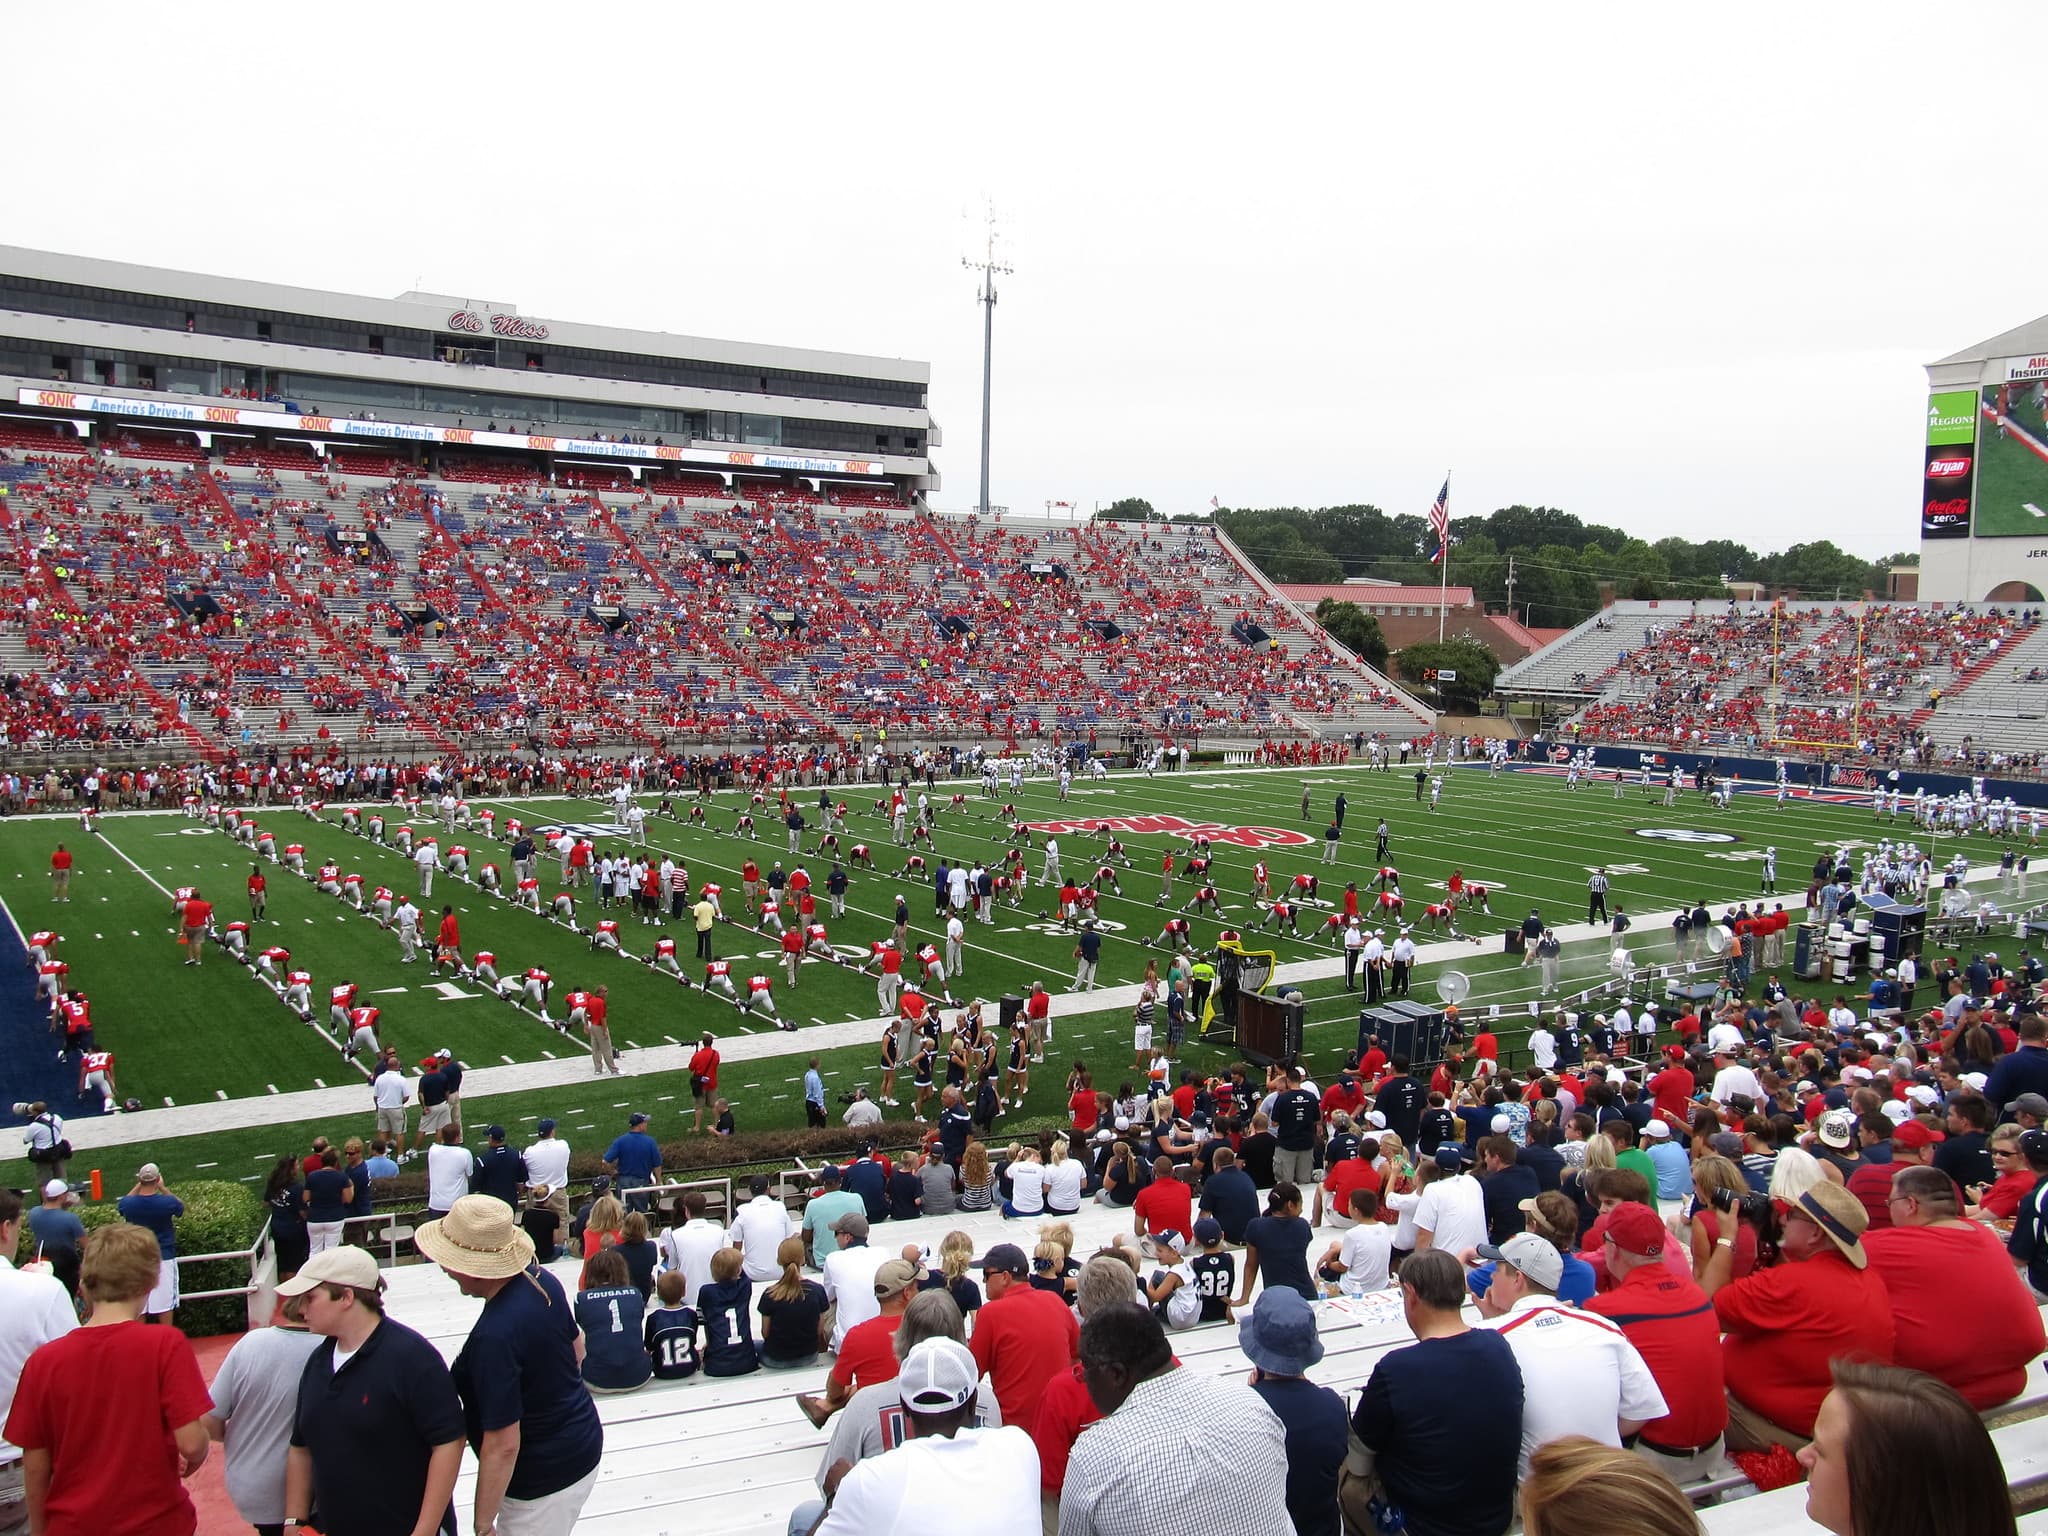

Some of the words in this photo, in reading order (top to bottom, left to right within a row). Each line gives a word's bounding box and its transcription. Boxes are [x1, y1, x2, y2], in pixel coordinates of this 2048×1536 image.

[448, 310, 483, 332] Ole
[490, 314, 549, 339] Miss
[38, 391, 76, 409] SONIC
[90, 398, 146, 416] America's
[149, 404, 194, 420] Drive-In
[205, 407, 240, 424] SONIC
[1930, 416, 1975, 427] REGIONS
[299, 416, 333, 432] SONIC
[345, 421, 392, 438] America's
[394, 427, 434, 440] Drive-In
[442, 429, 475, 444] SONIC
[527, 436, 556, 450] SONIC
[567, 441, 609, 456] America's
[611, 445, 647, 458] Drive-In
[655, 447, 683, 460] SONIC
[728, 451, 754, 466] SONIC
[764, 456, 803, 470] America's
[804, 458, 838, 472] Drive-In
[844, 460, 870, 473] SONIC
[1931, 461, 1965, 475] Bryan
[1933, 515, 1957, 523] zero
[1423, 668, 1437, 680] 25
[1640, 753, 1666, 765] FedEx
[323, 868, 337, 878] 50
[574, 992, 585, 1004] 2
[71, 1002, 84, 1016] 5
[360, 1009, 370, 1023] 7
[1571, 1032, 1579, 1047] 9
[1607, 1034, 1613, 1049] 9
[88, 1052, 108, 1068] 37
[1201, 1270, 1230, 1297] 32
[587, 1288, 636, 1300] COUGARS
[608, 1299, 624, 1333] 1
[1534, 1315, 1563, 1328] REBELS
[724, 1307, 743, 1345] 1
[661, 1337, 693, 1367] 12
